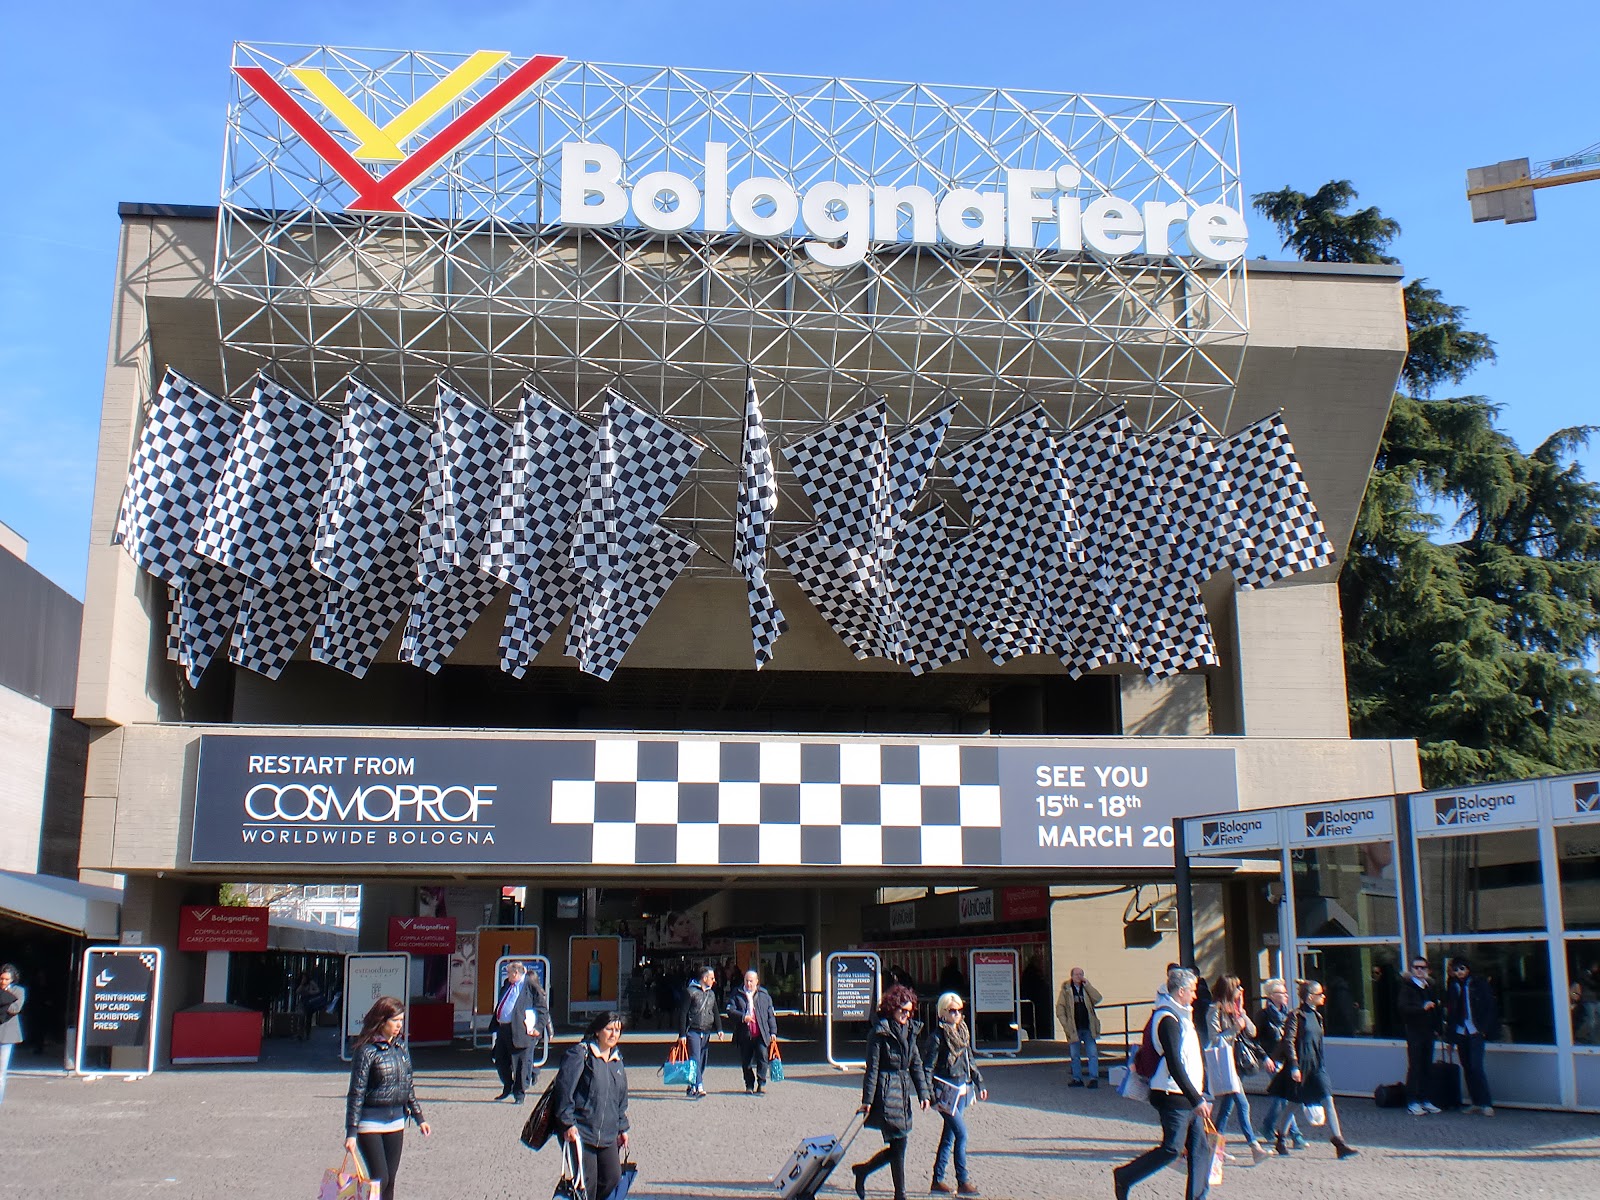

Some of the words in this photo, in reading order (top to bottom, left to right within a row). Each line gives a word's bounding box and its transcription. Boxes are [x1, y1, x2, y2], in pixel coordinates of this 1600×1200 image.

[560, 141, 1249, 268] BolognaFiere
[248, 755, 348, 775] RESTART
[353, 757, 416, 776] FROM
[1036, 765, 1086, 787] SEE
[1093, 766, 1149, 788] YOU
[244, 783, 498, 822] COSMOPROF
[1036, 794, 1079, 817] 15th
[1098, 795, 1142, 817] 18th
[1458, 794, 1516, 811] Bologna
[1325, 809, 1375, 826] Bologna
[1459, 811, 1491, 824] Fiere
[1219, 819, 1262, 835] Bologna
[1326, 823, 1353, 837] Fiere
[241, 829, 377, 845] WORLDWIDE
[388, 830, 496, 845] BOLOGNA
[1038, 825, 1133, 848] MARCH
[1220, 834, 1244, 846] Fiere
[967, 896, 992, 917] UniCredit
[211, 914, 260, 923] BolognaFiere
[94, 993, 146, 1001] PRINT@HOME
[94, 1003, 108, 1011] VIP
[108, 1003, 130, 1011] CARD
[93, 1012, 140, 1021] EXHIBITORS
[93, 1022, 119, 1030] PRESS
